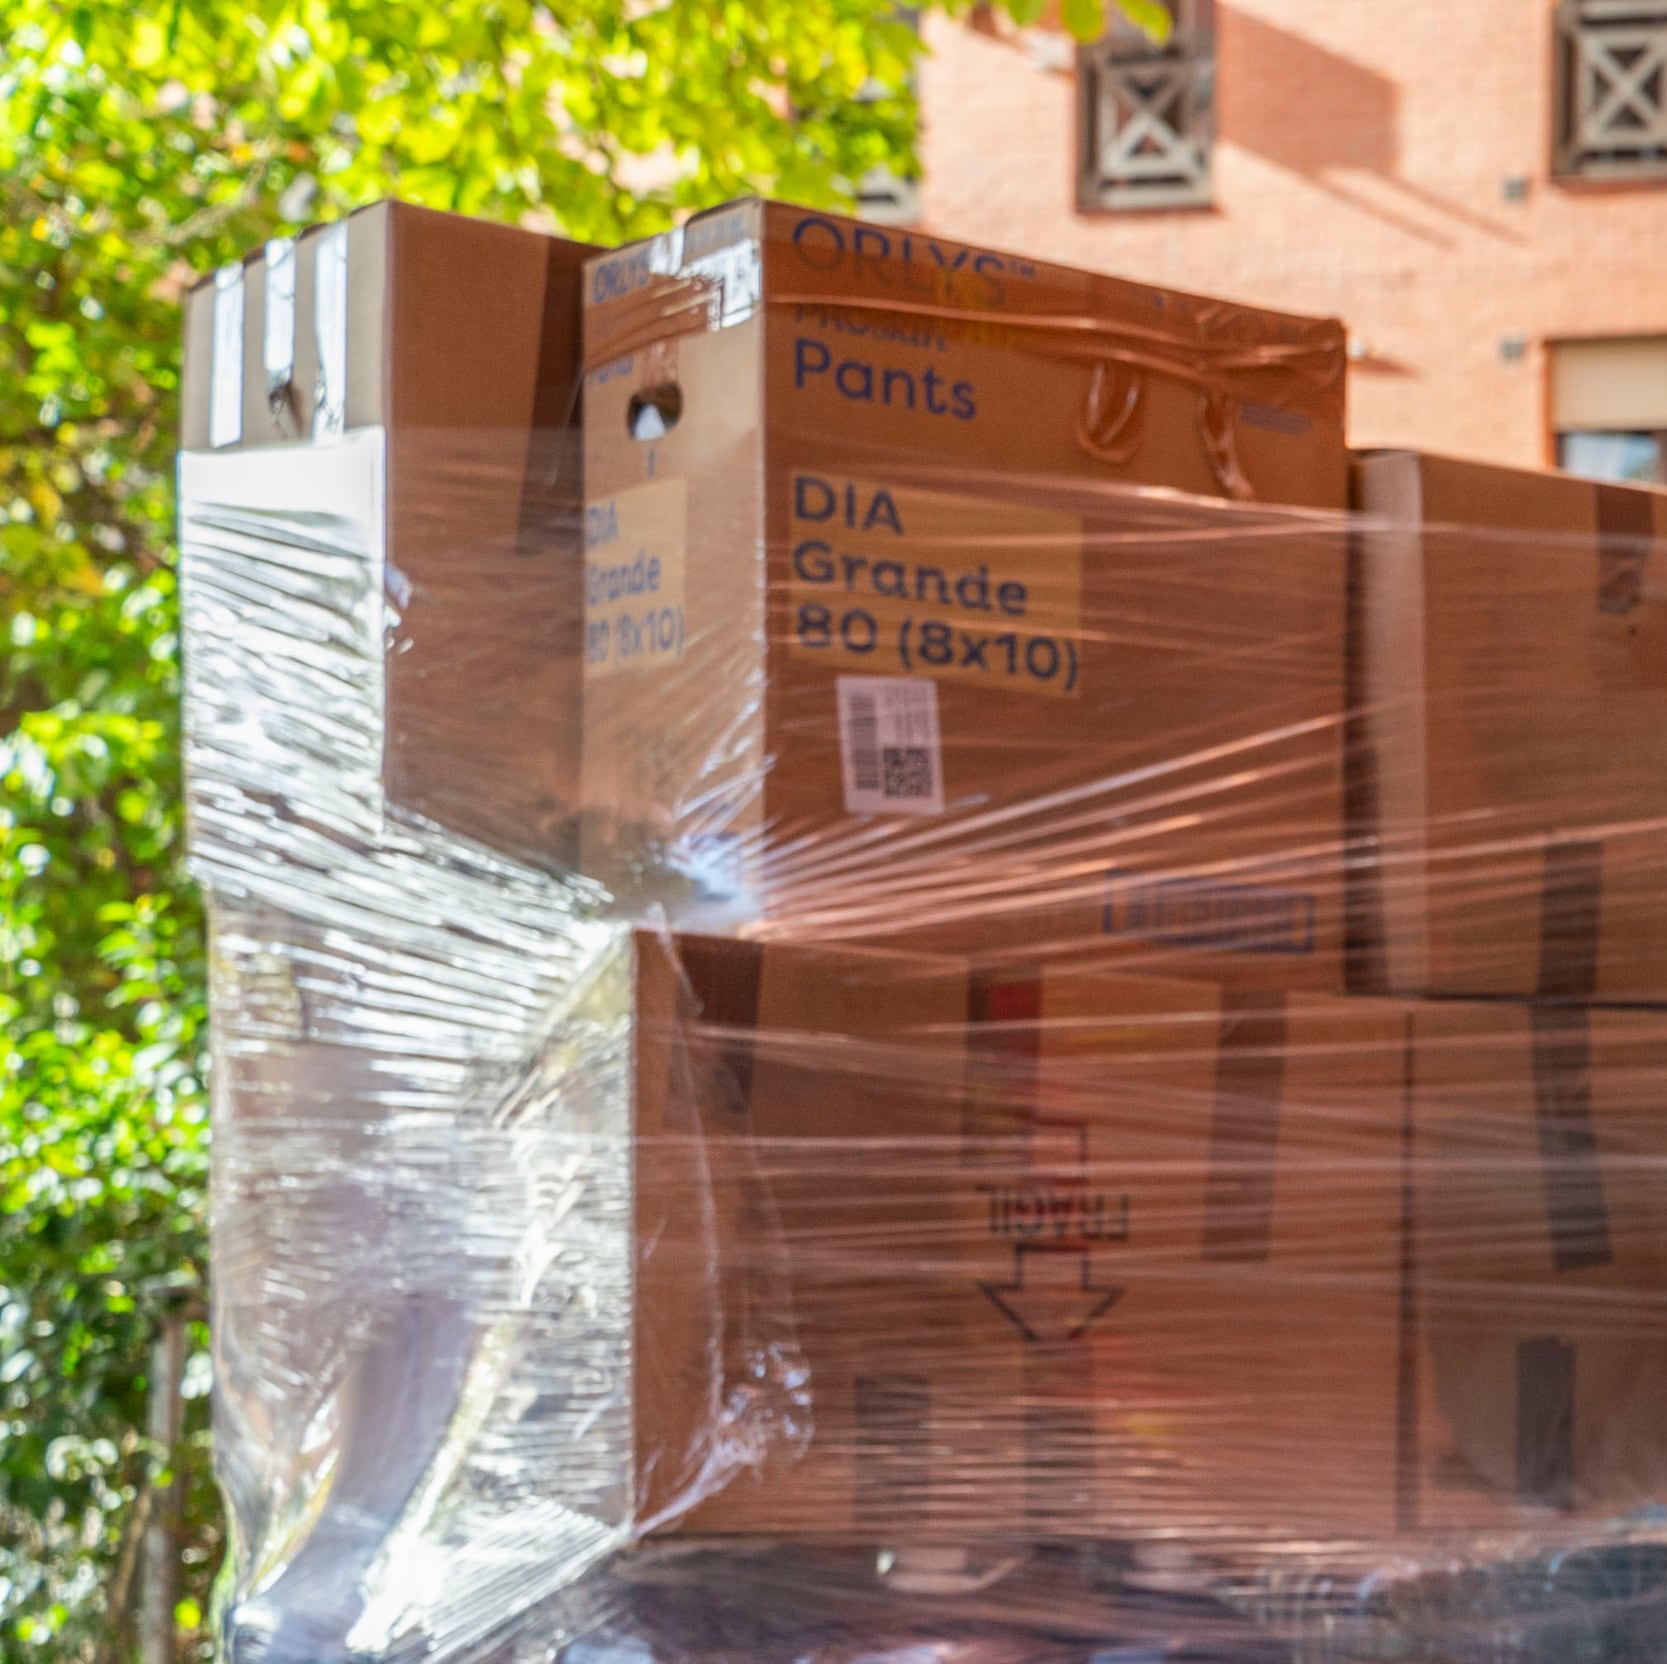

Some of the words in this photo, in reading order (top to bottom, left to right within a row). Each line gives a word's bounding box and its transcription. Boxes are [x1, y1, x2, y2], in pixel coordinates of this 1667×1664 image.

[794, 338, 976, 422] Pants
[794, 473, 904, 537] DIA
[793, 539, 1030, 617] Grande
[797, 602, 878, 654] 80
[898, 617, 1079, 693] (8x10)
